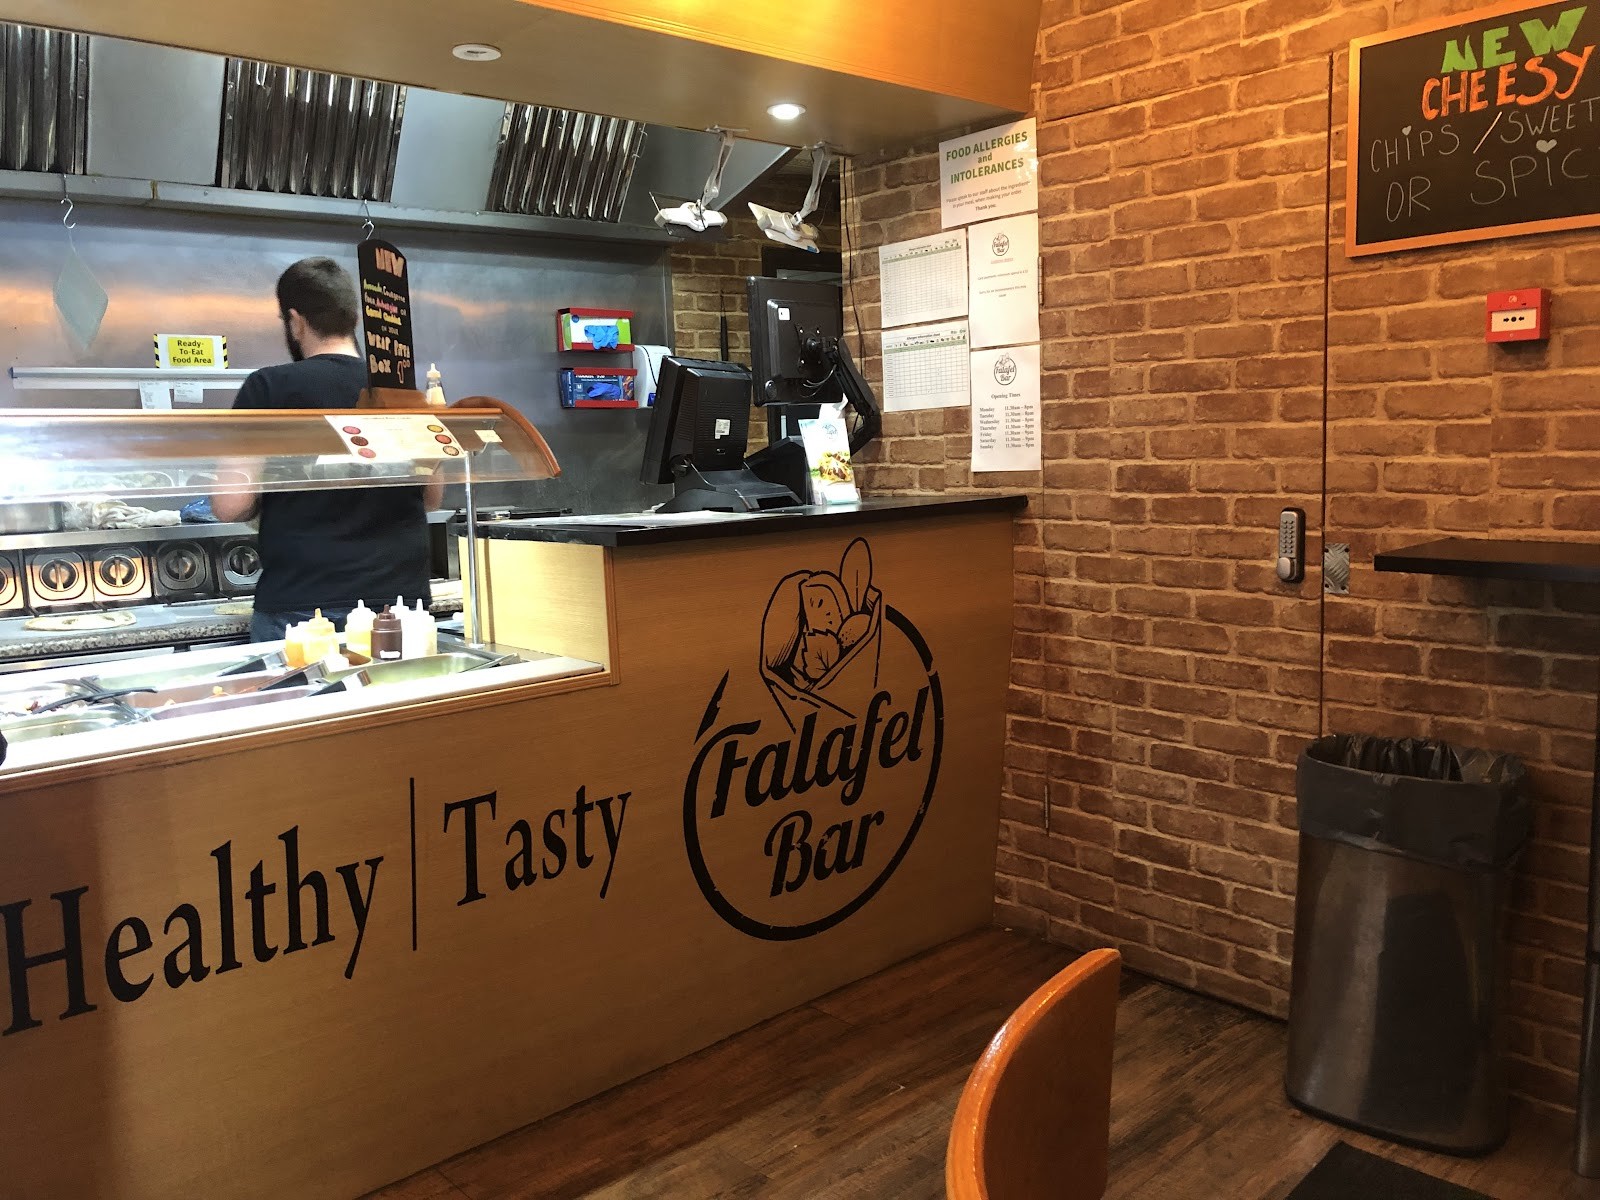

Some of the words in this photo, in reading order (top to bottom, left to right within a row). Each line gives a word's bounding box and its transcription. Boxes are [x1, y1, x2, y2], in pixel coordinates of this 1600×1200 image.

[1441, 6, 1587, 73] NEW
[1421, 45, 1596, 121] CHEESY
[946, 146, 971, 161] FOOD
[973, 131, 1028, 154] ALLERGIES
[950, 157, 1024, 184] INTOLERANCES
[977, 152, 993, 163] and
[1386, 176, 1430, 222] OR
[1470, 139, 1600, 205] SPIC
[375, 247, 405, 278] NEW
[177, 340, 204, 348] Ready-
[1000, 374, 1011, 382] Bar
[708, 685, 930, 819] Falafel
[764, 809, 885, 898] Bar
[1, 825, 384, 1037] Healthy
[443, 785, 632, 907] Tasty
